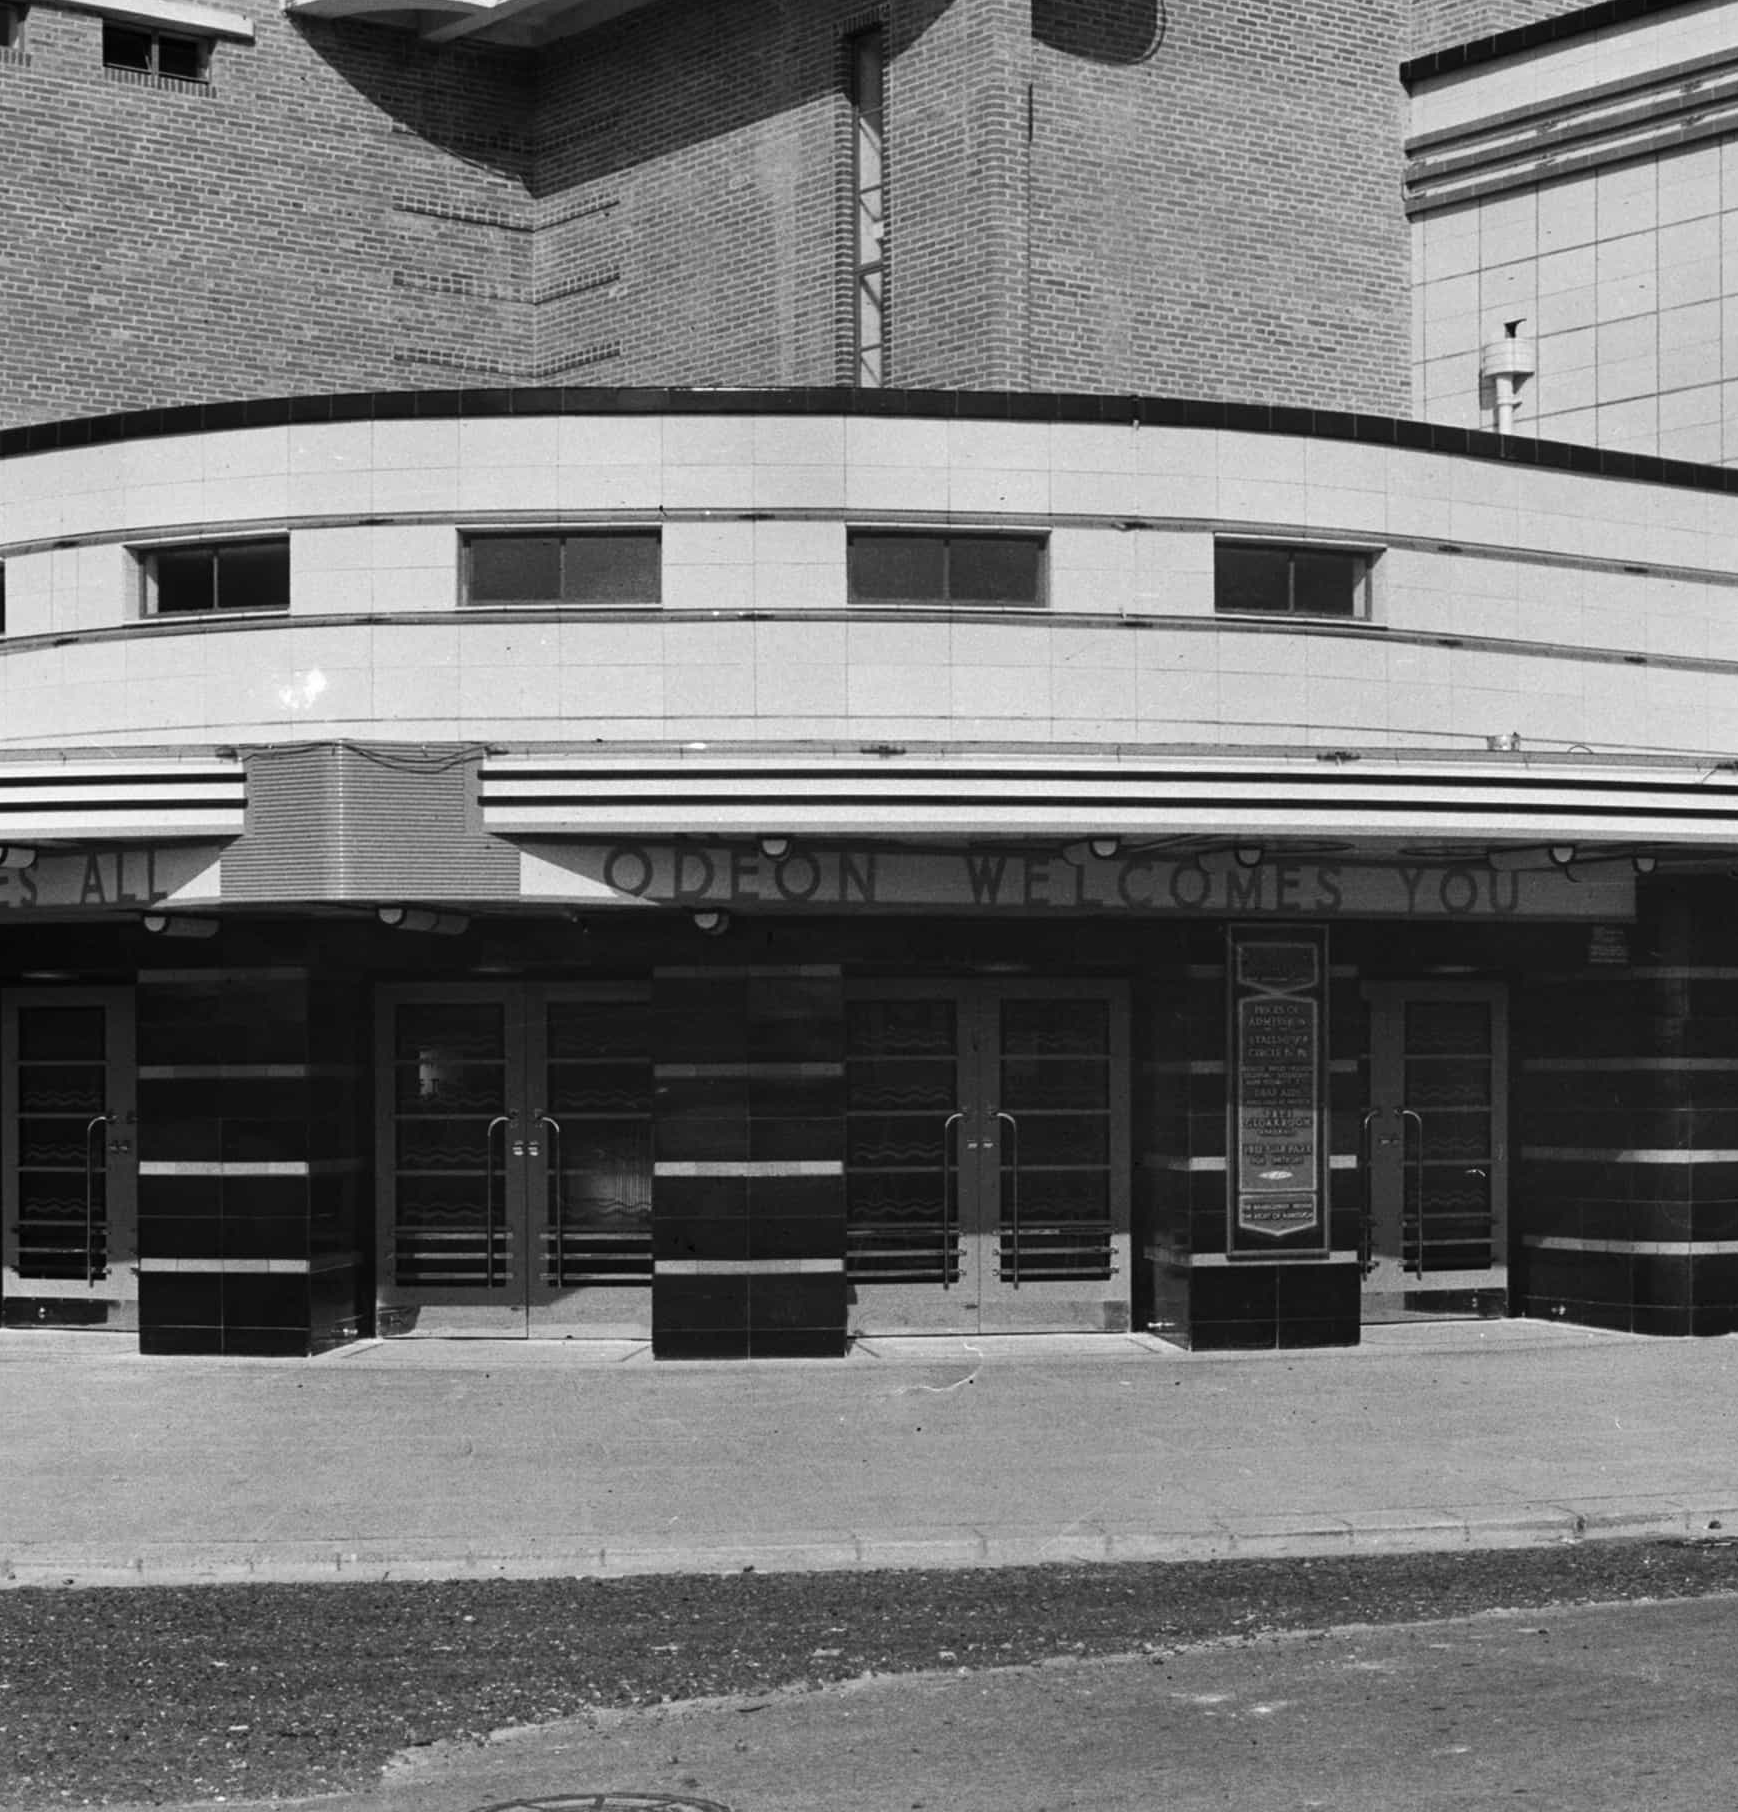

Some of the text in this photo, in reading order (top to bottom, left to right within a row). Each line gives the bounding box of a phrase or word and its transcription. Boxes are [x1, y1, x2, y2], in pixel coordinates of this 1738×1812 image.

[80, 851, 168, 906] ALL
[603, 846, 1519, 913] ODEON WELCOMES YOU
